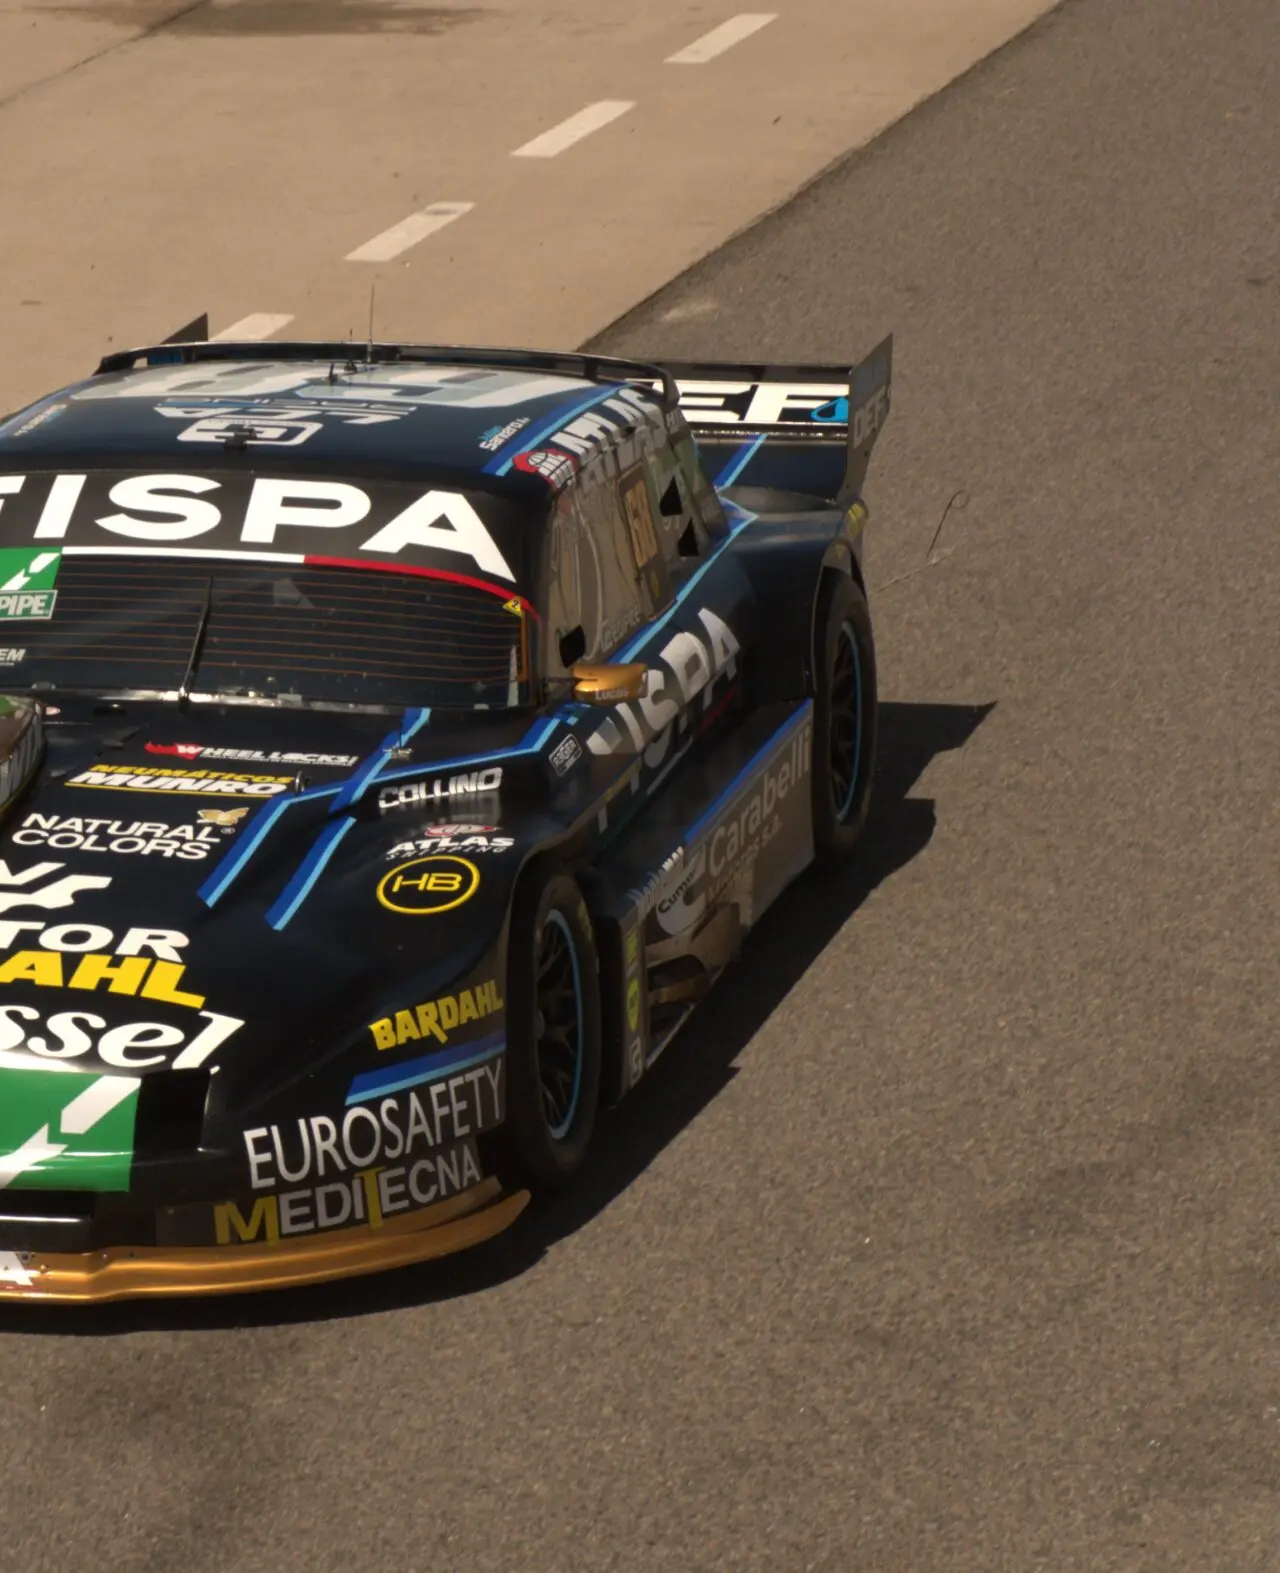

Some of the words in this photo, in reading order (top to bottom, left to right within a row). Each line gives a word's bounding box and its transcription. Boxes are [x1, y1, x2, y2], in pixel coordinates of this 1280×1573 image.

[68, 771, 287, 795] MUNRO
[378, 767, 503, 809] COLLINO
[709, 726, 813, 878] Carabelli
[12, 829, 211, 860] COLORS
[21, 813, 220, 843] NATURAL
[386, 836, 515, 855] ATLAS
[392, 872, 462, 893] HB
[369, 980, 505, 1051] BARDAHL
[243, 1059, 505, 1190] EUROSAFETY
[214, 1145, 481, 1246] MEDITECNA
